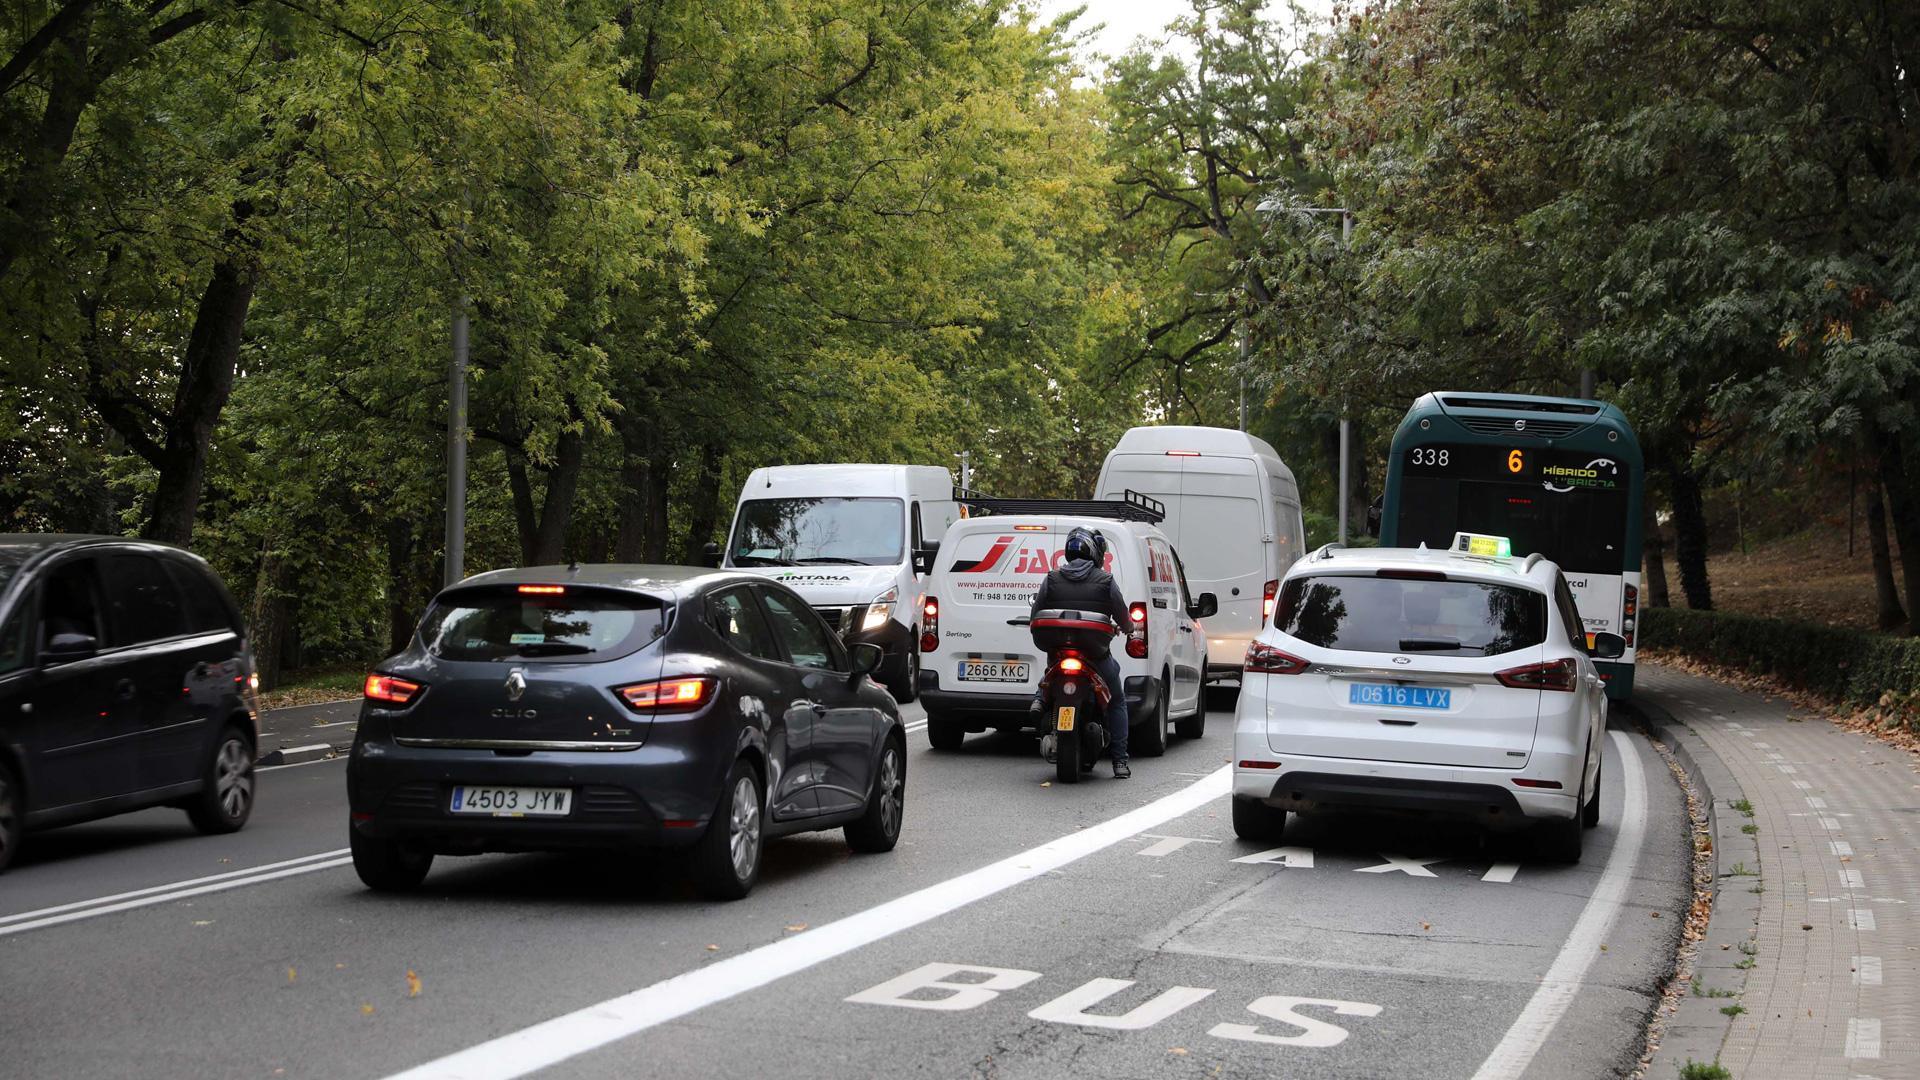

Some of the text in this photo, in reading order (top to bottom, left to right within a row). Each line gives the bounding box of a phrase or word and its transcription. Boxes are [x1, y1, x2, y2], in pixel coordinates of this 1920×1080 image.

[1412, 448, 1449, 467] 338
[1508, 449, 1524, 473] 6
[1543, 465, 1598, 478] HÍBRIDO
[1567, 578, 1588, 589] rcal
[987, 593, 1001, 601] 948
[1004, 593, 1017, 601] 126
[946, 630, 973, 639] Berlingo
[967, 664, 1024, 678] 2666 KKC
[1361, 686, 1447, 707] 0616 LVX
[491, 708, 537, 718] CLIO
[467, 790, 566, 810] 4503 JYW
[1136, 834, 1520, 882] TAXI
[842, 963, 1384, 1048] BUS
